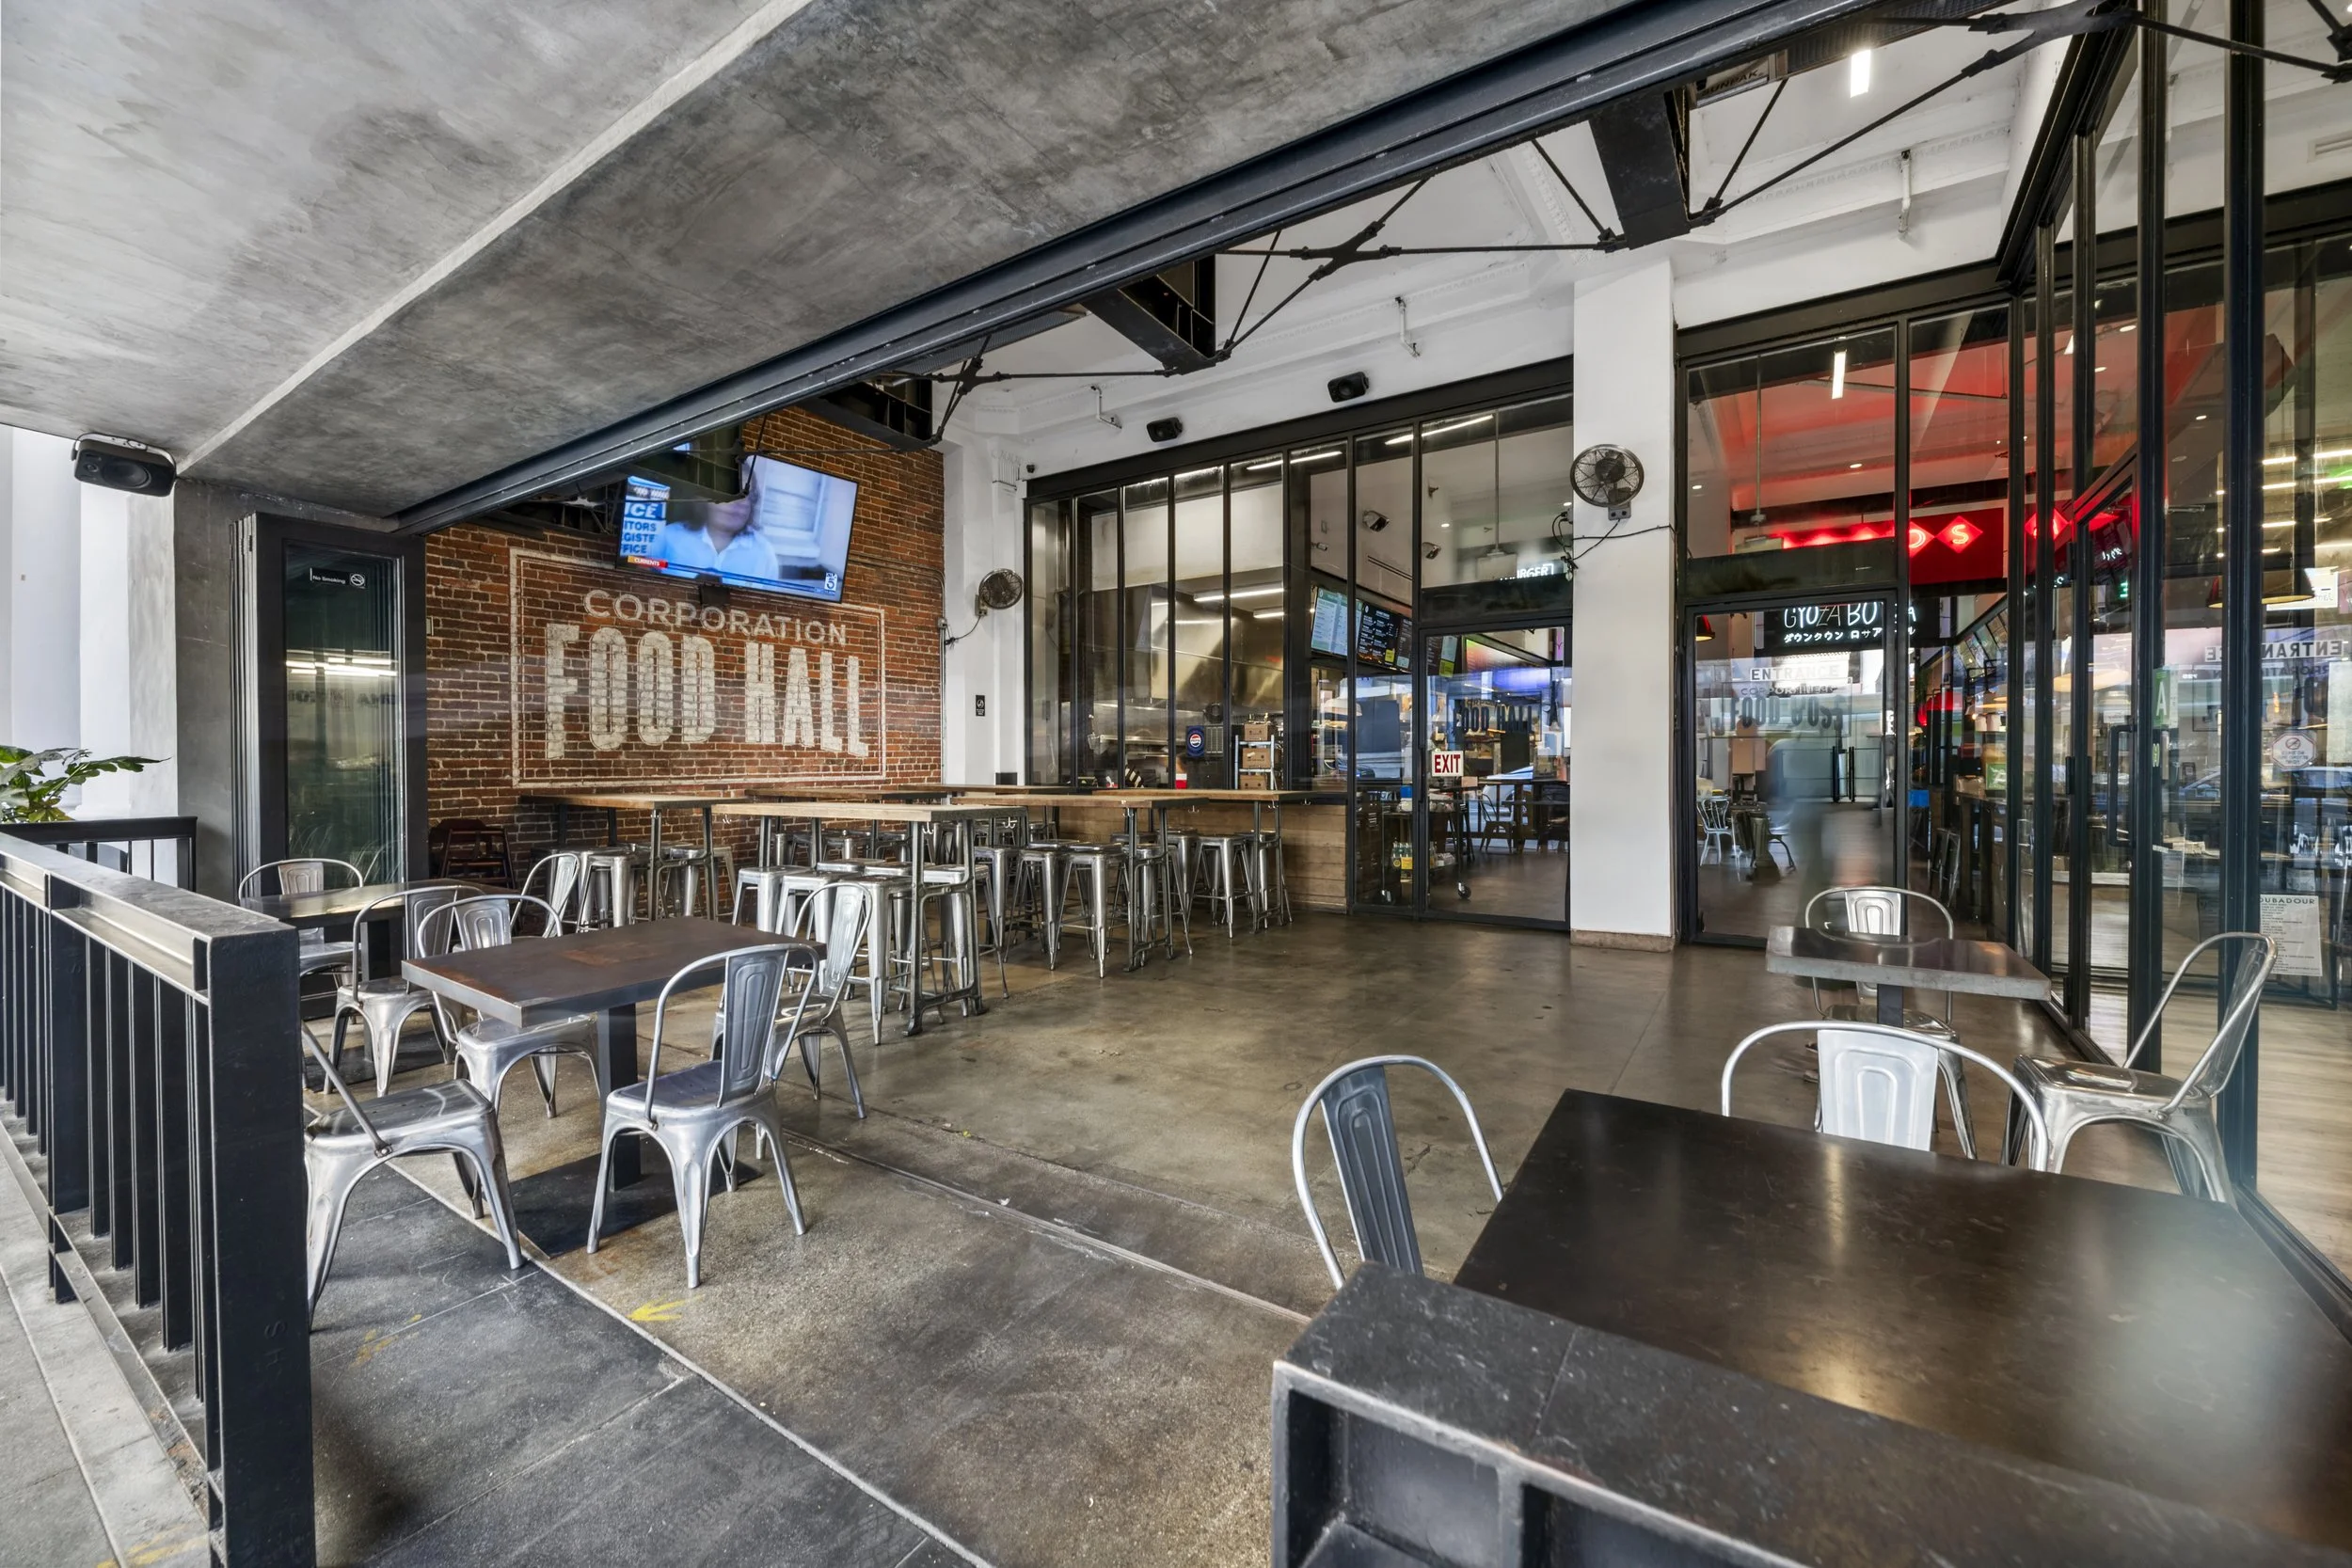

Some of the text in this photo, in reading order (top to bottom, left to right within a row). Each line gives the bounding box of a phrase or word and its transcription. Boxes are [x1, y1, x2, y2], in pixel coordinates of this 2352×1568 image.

[322, 577, 346, 585] Smoking
[583, 589, 847, 646] CORPORATION
[1752, 664, 1839, 680] ENTRANCE
[546, 623, 869, 760] FOOD HALL
[1434, 753, 1461, 773] EXIT
